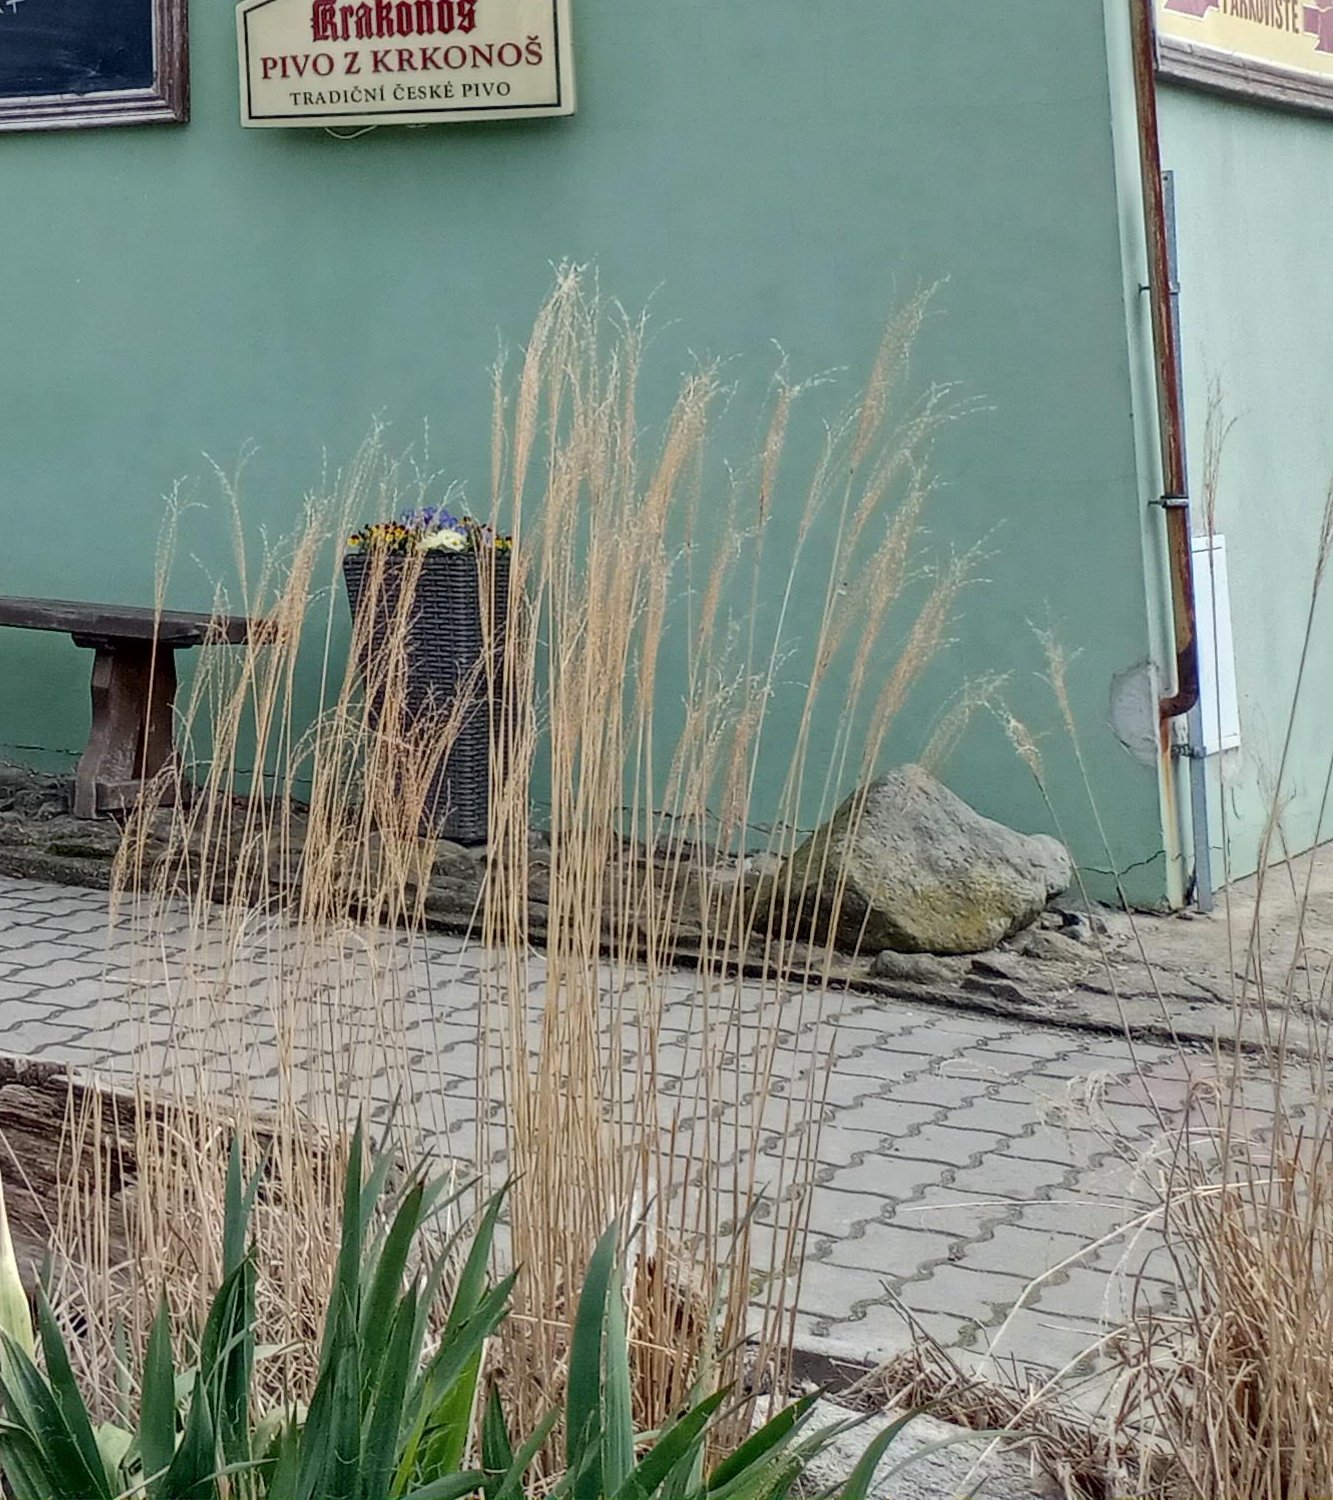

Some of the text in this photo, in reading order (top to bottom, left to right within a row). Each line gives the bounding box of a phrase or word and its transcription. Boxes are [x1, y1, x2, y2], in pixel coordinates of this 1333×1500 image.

[261, 35, 544, 80] PIVO Z KRKONOŠ
[289, 80, 511, 107] TRADIČNÍ ČESKÉ PIVO
